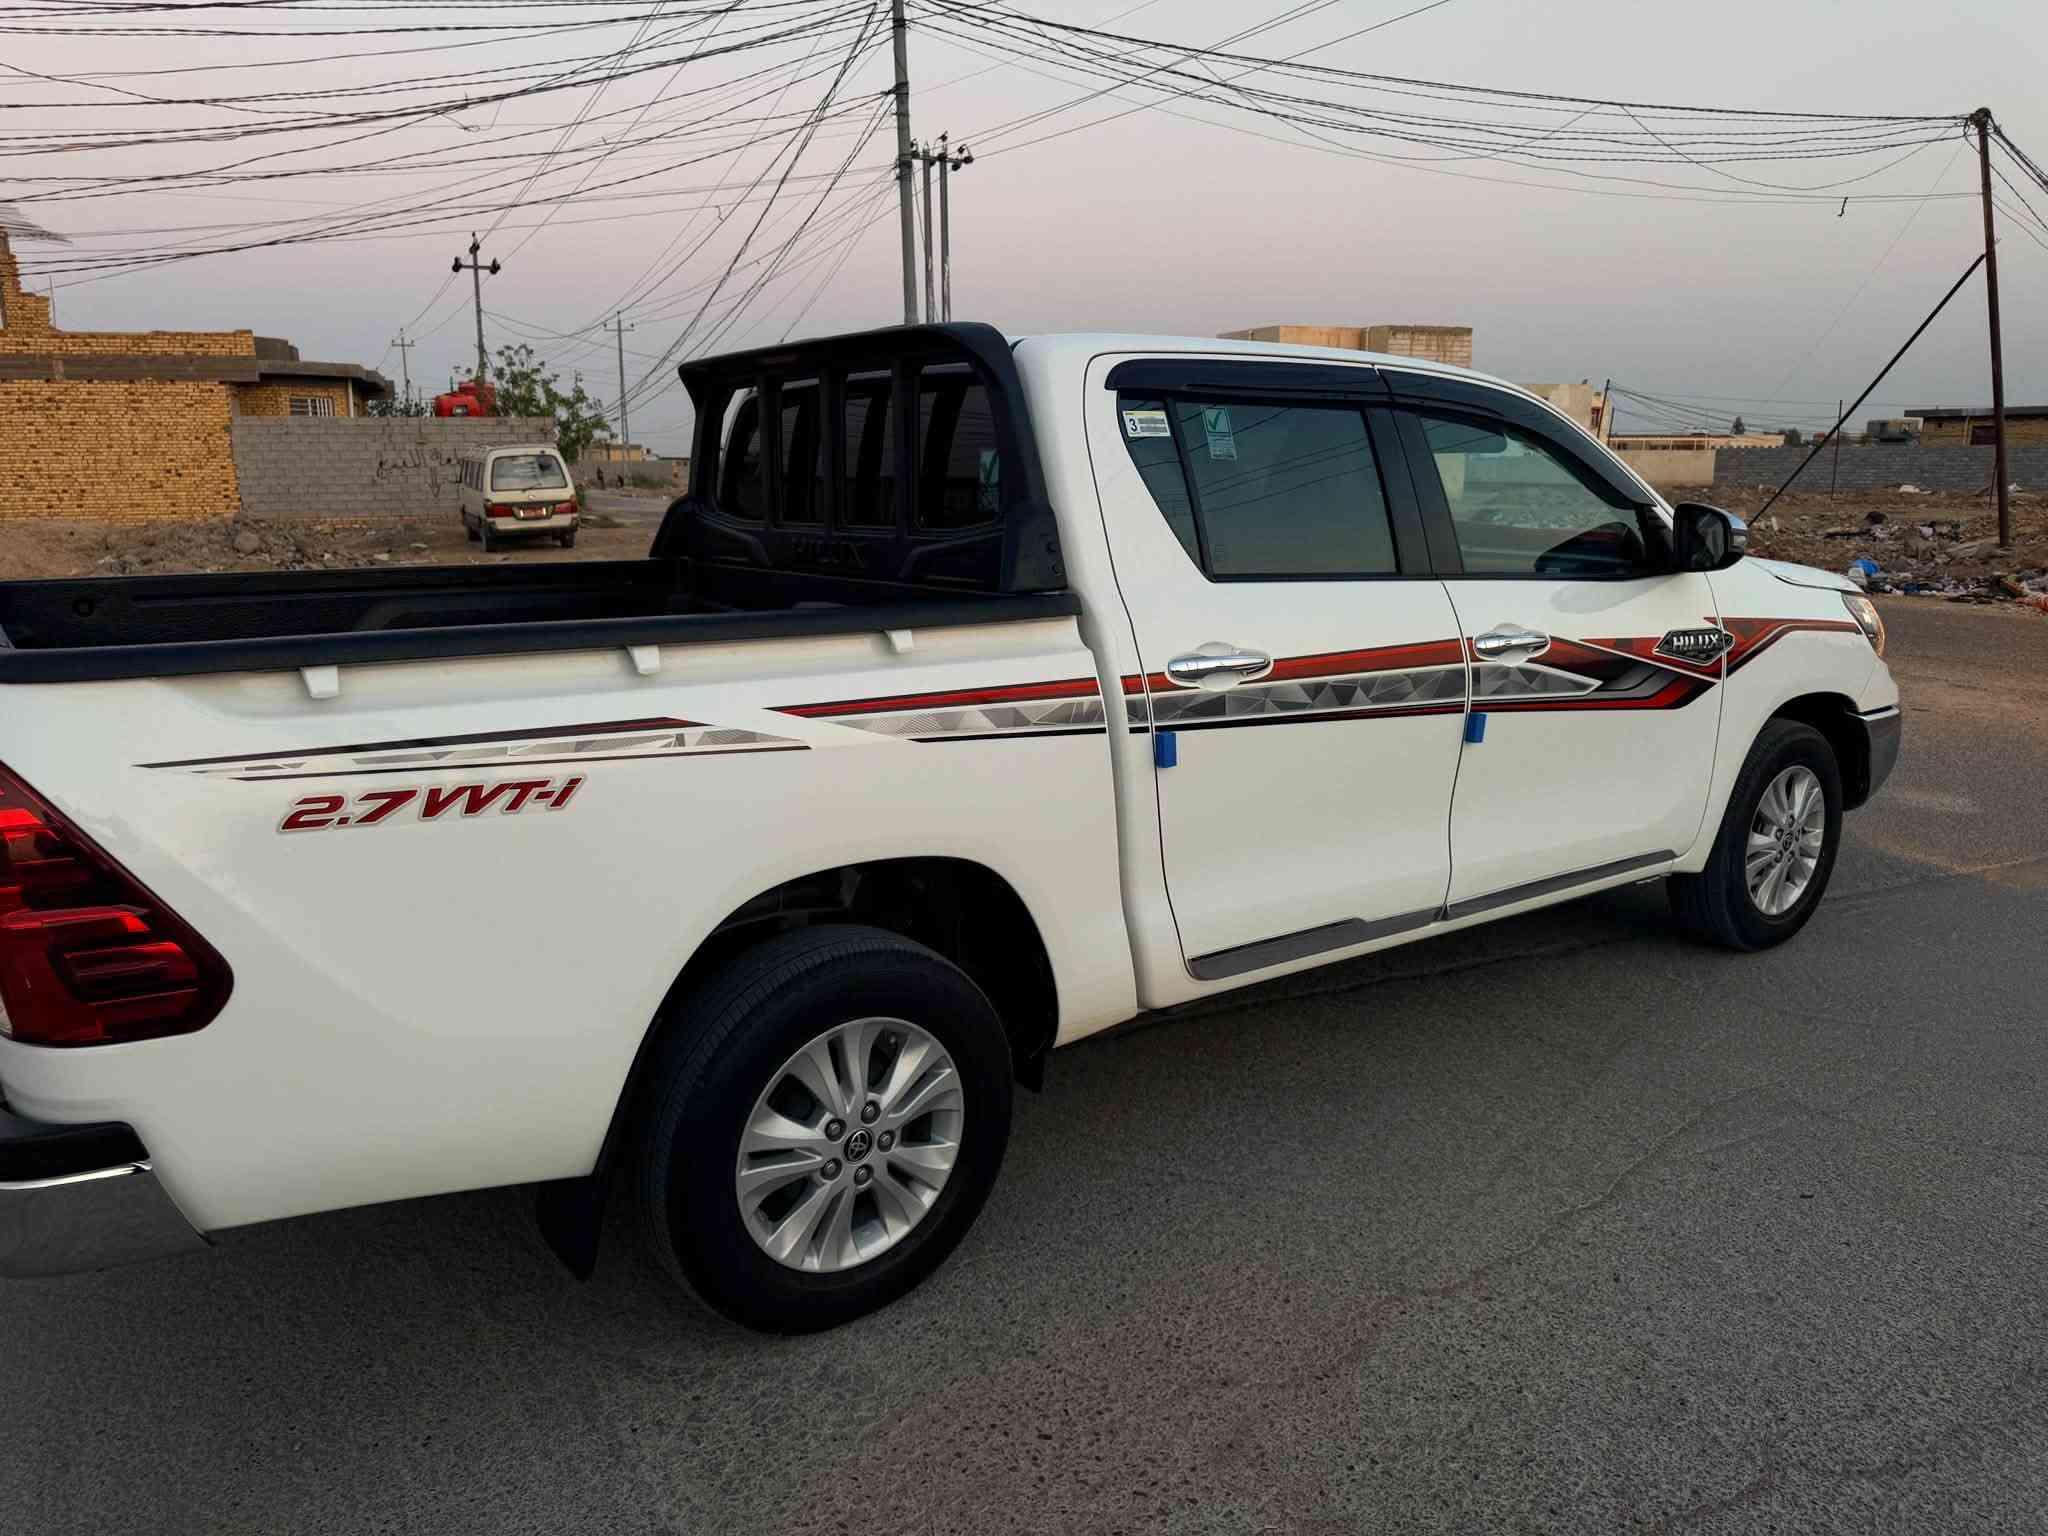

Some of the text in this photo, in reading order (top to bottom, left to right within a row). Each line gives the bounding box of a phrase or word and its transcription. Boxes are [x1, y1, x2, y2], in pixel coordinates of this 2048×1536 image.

[1128, 418, 1138, 432] 3
[1672, 634, 1719, 650] HILUX
[280, 795, 419, 832] 2.7
